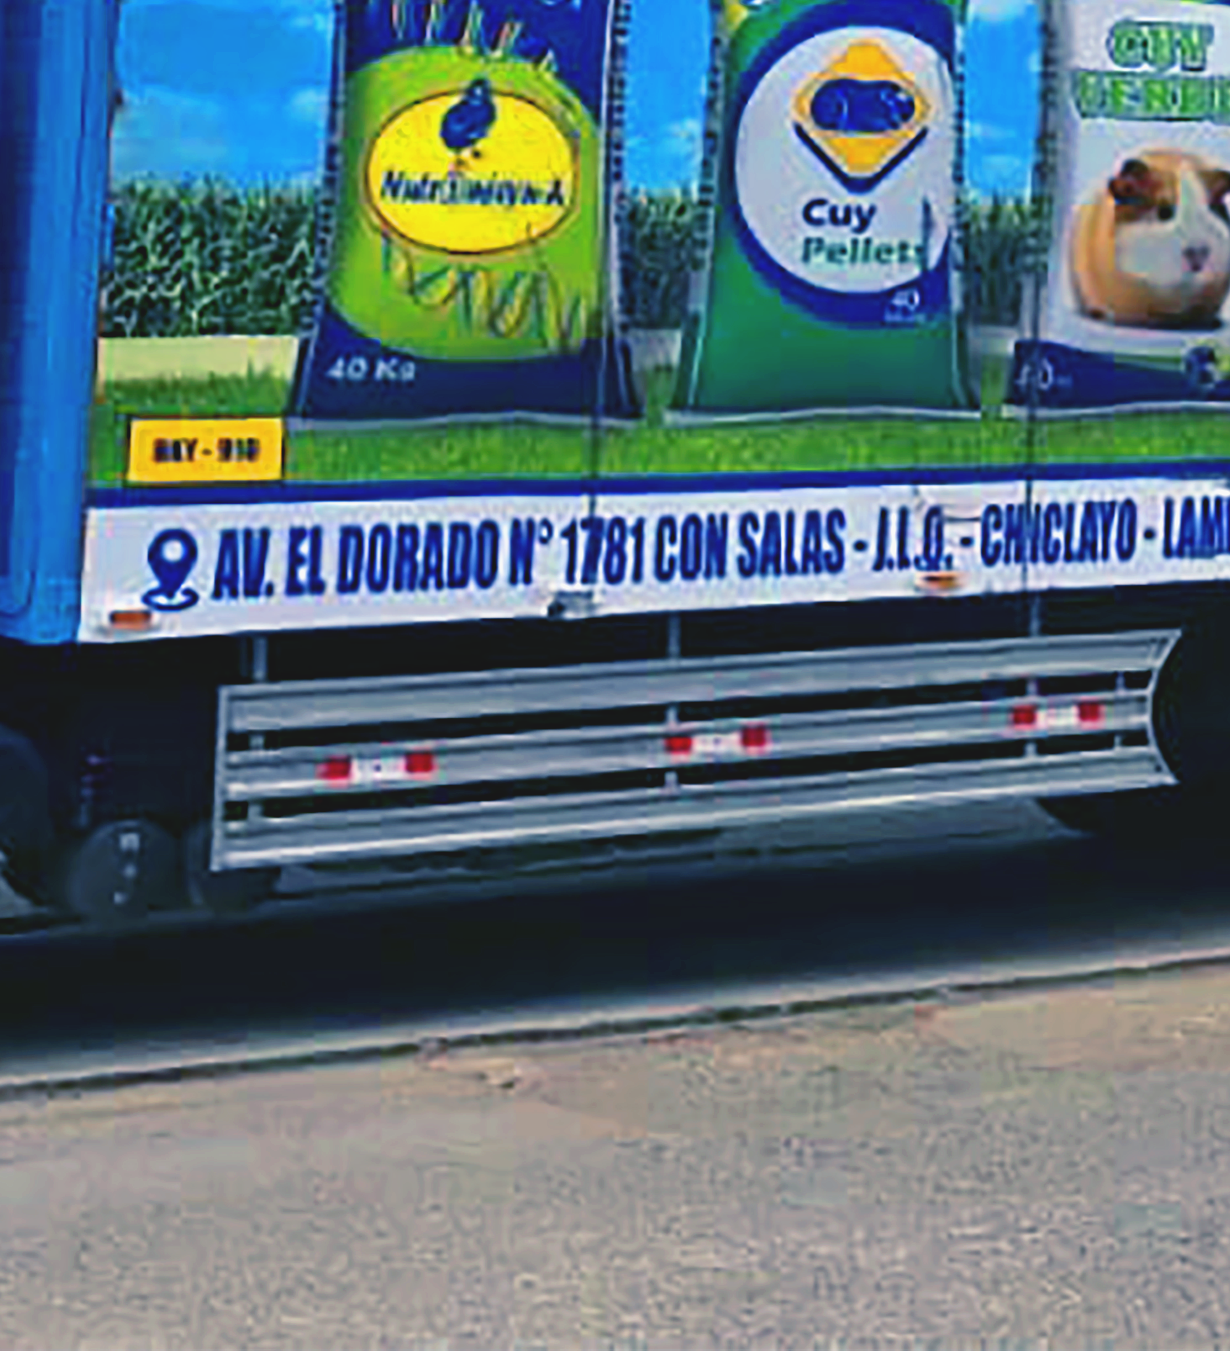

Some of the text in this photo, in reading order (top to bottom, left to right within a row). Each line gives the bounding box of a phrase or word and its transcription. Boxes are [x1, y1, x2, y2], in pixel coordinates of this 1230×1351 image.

[802, 198, 877, 234] Cuy
[326, 356, 367, 382] 40
[211, 527, 275, 600] AV.
[285, 525, 326, 597] EL
[336, 519, 501, 594] DORADO
[560, 515, 646, 586] 1781
[653, 512, 728, 583] CON
[736, 507, 847, 579] SALAS
[980, 498, 1138, 568] CHICLAYO
